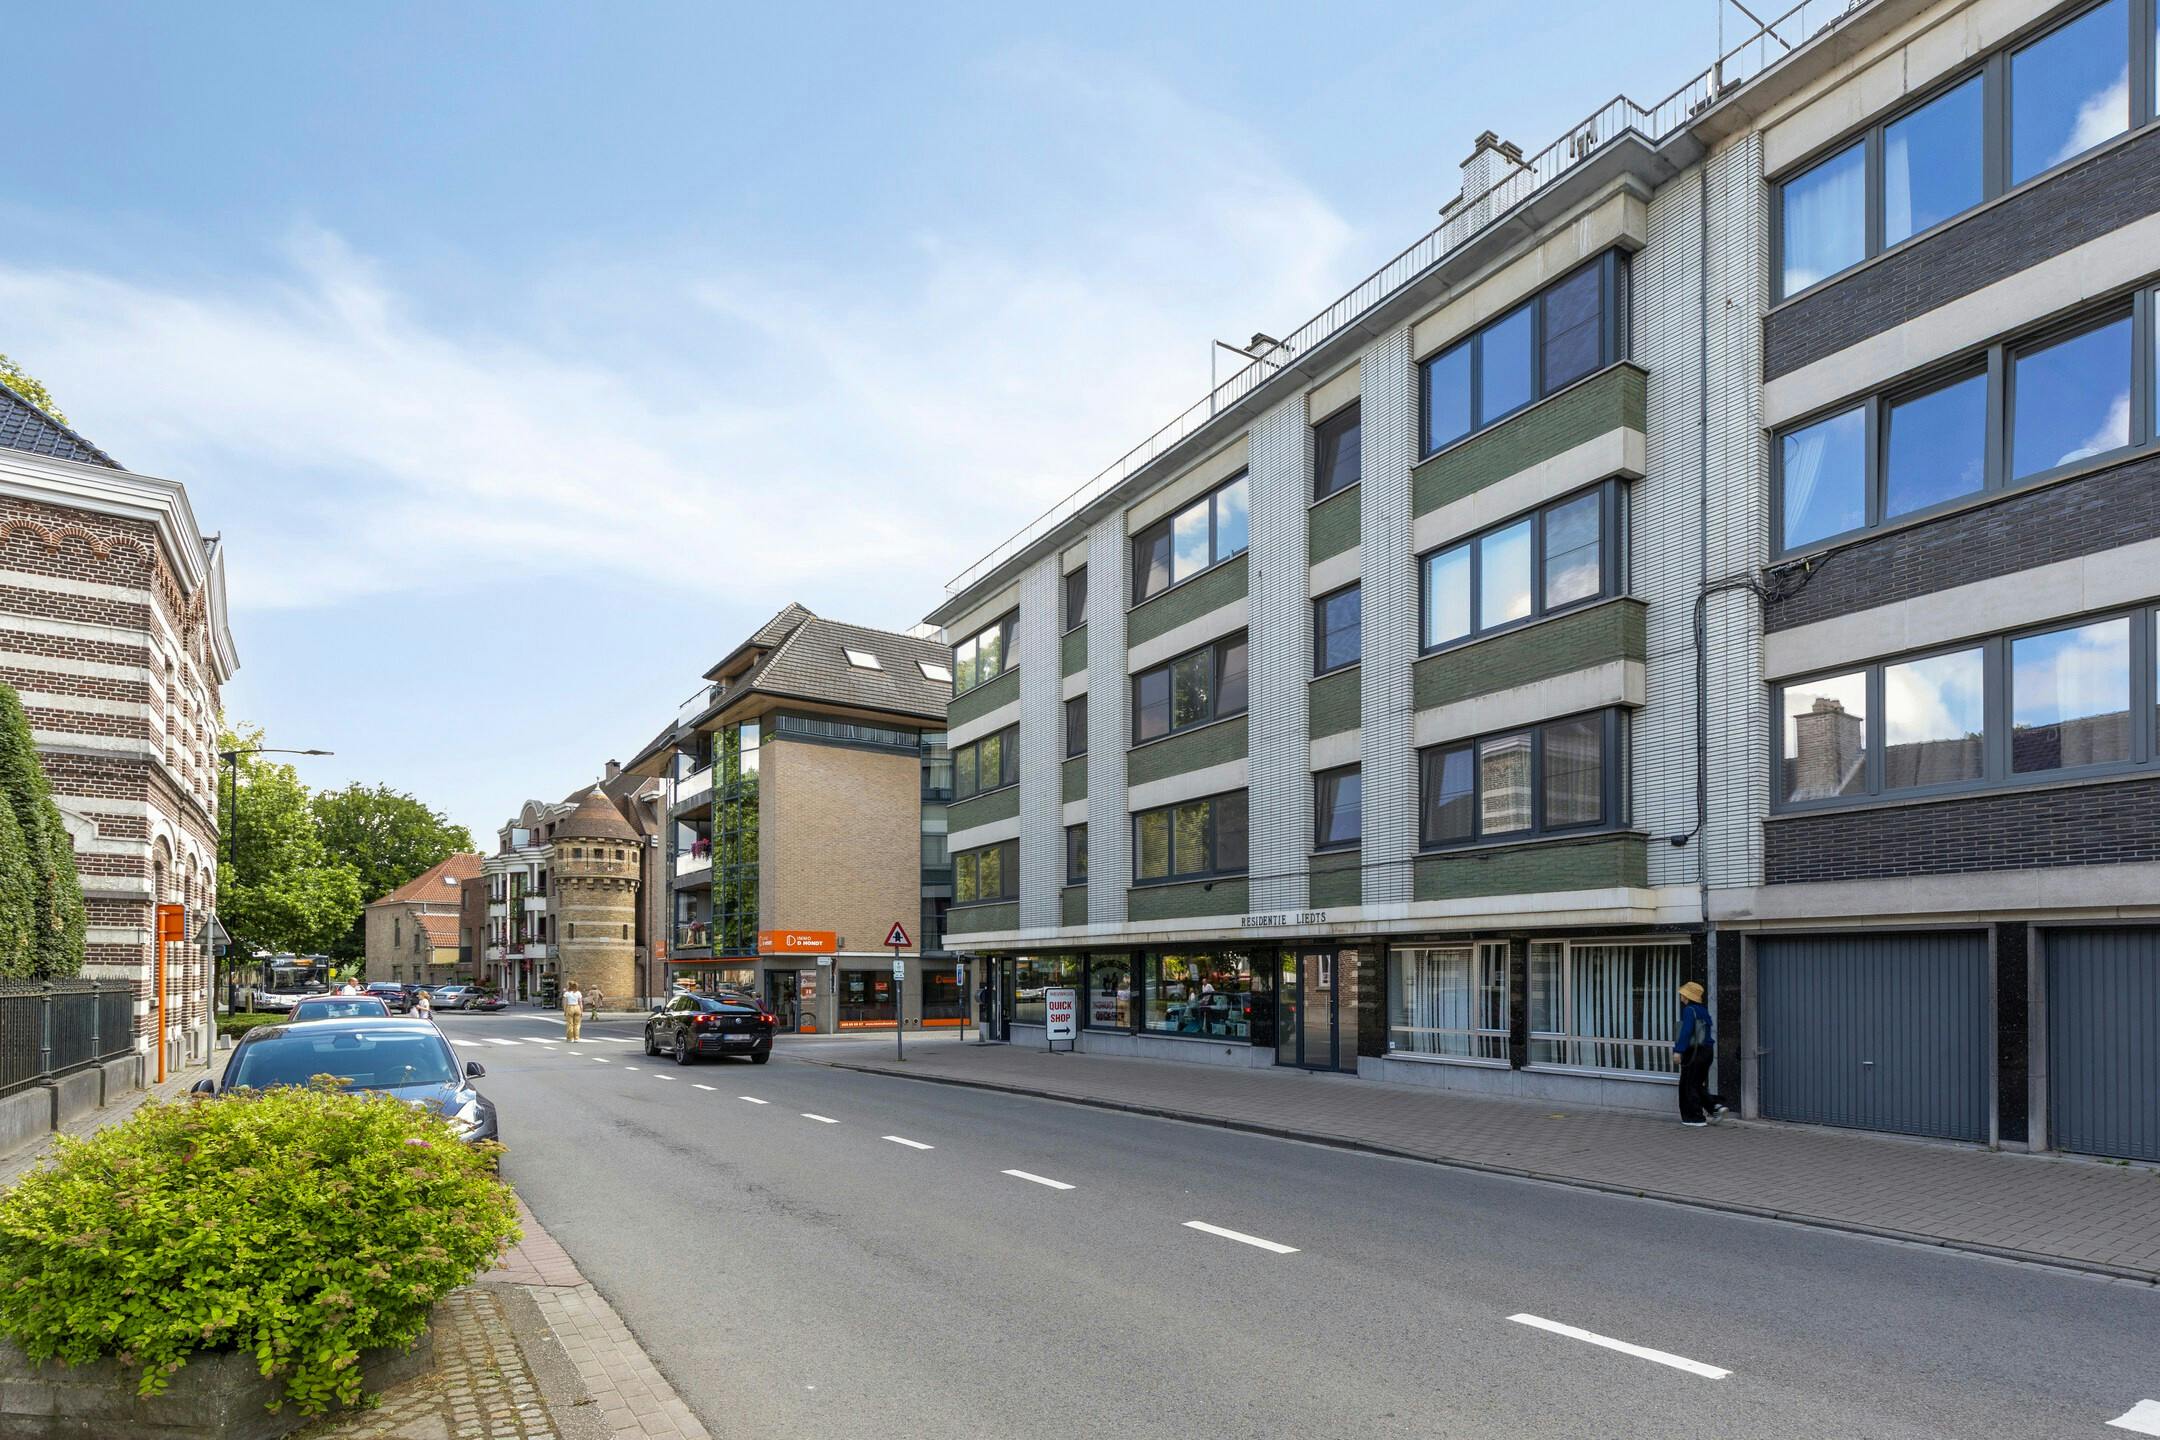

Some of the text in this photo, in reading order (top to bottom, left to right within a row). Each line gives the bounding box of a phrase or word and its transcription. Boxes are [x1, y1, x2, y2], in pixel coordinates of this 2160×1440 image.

[1241, 912, 1327, 927] RESIDENTIE LIEDTS
[1049, 1001, 1073, 1011] QUICK
[1050, 1013, 1071, 1023] SHOP
